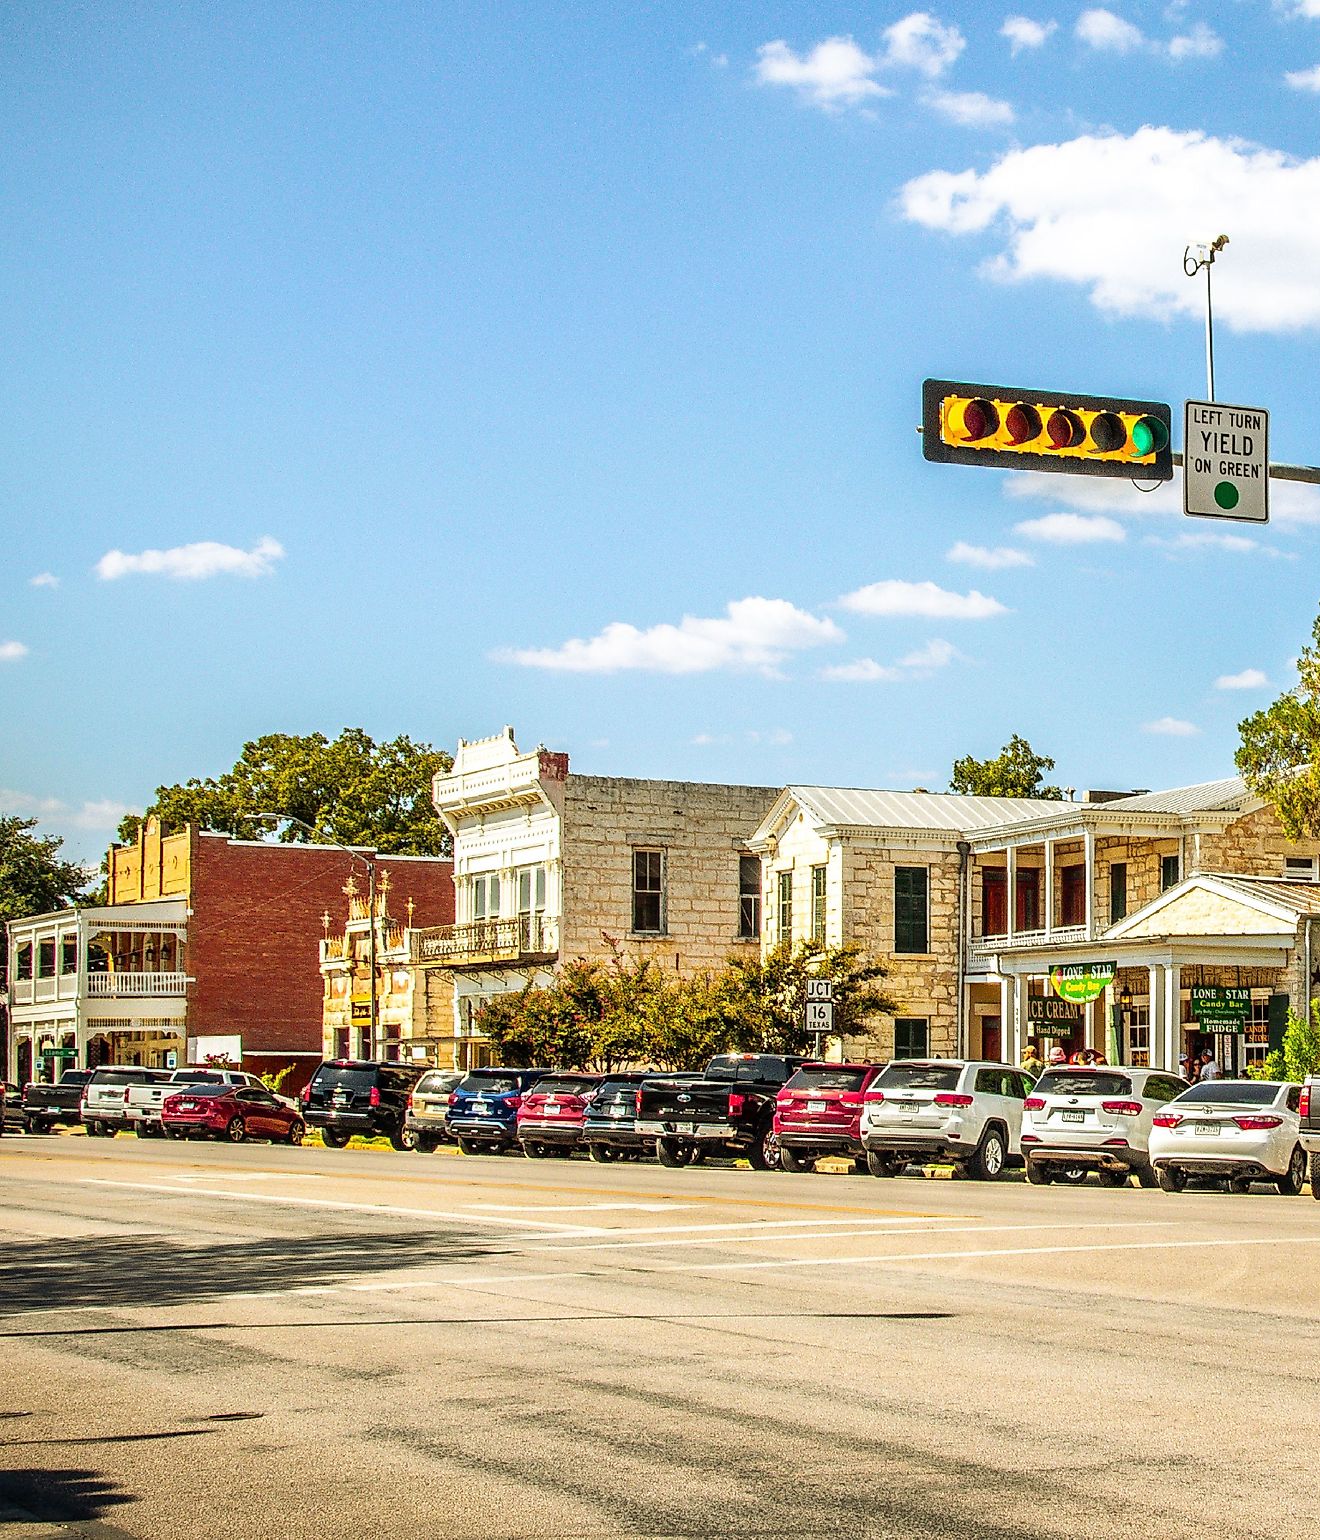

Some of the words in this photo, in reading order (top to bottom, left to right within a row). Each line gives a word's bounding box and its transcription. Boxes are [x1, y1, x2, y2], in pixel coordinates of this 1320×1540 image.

[1194, 408, 1222, 426] LEFT
[1229, 412, 1261, 430] TURN
[1201, 431, 1253, 456] YIELD
[1062, 966, 1084, 980] LONE
[1091, 964, 1112, 979] STAR
[808, 982, 830, 996] JCT
[1193, 989, 1217, 999] LONE
[1225, 990, 1249, 999] STAR
[1028, 1000, 1044, 1018] ICE
[1046, 1001, 1078, 1019] CREAM
[1200, 1000, 1225, 1009] Candy
[813, 1005, 826, 1019] 16
[809, 1021, 830, 1029] TEXAS
[1036, 1026, 1050, 1034] Hand
[1051, 1026, 1071, 1036] Dipped
[1249, 1034, 1268, 1042] STOR
